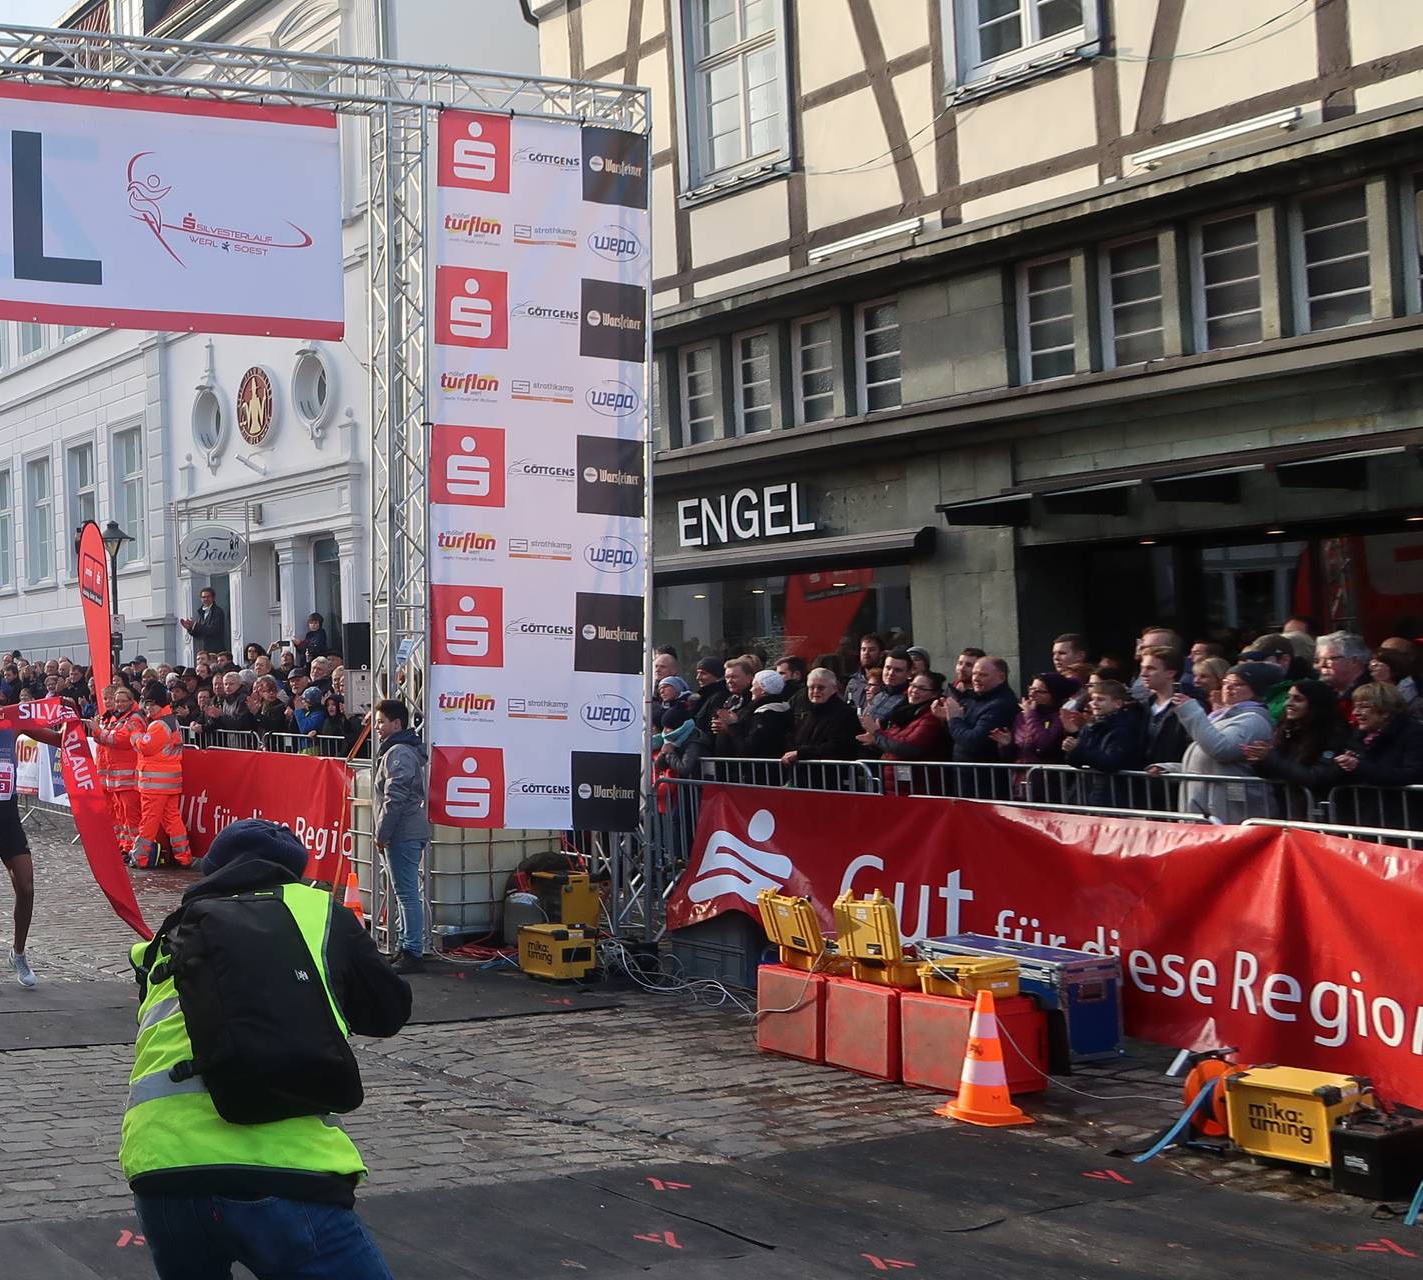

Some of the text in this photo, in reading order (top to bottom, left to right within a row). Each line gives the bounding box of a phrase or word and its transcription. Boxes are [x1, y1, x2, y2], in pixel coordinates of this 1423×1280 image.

[528, 152, 580, 166] GÖTTGENS
[196, 222, 274, 244] SILVESTERLAUF
[444, 214, 502, 236] turflon
[189, 235, 269, 257] WERL SOEST
[594, 236, 637, 256] wepa
[527, 306, 579, 320] GÖTTGENS
[440, 373, 499, 394] turflon
[591, 391, 634, 411] wepa
[523, 463, 575, 477] GÖTTGENS
[677, 482, 816, 547] ENGEL
[438, 532, 496, 553] turflon
[589, 548, 634, 567] wepa
[521, 622, 574, 635] GÖTTGENS
[597, 626, 639, 642] Warsteiner
[438, 693, 496, 714] turflon
[586, 705, 631, 725] wepa
[522, 783, 570, 795] GÖTTGENS
[593, 784, 636, 801] Warsteiner
[295, 816, 352, 860] Regio
[528, 949, 553, 966] timing
[1081, 925, 1217, 1005] diese
[1248, 1102, 1304, 1125] mika:
[1249, 1117, 1314, 1144] timing
